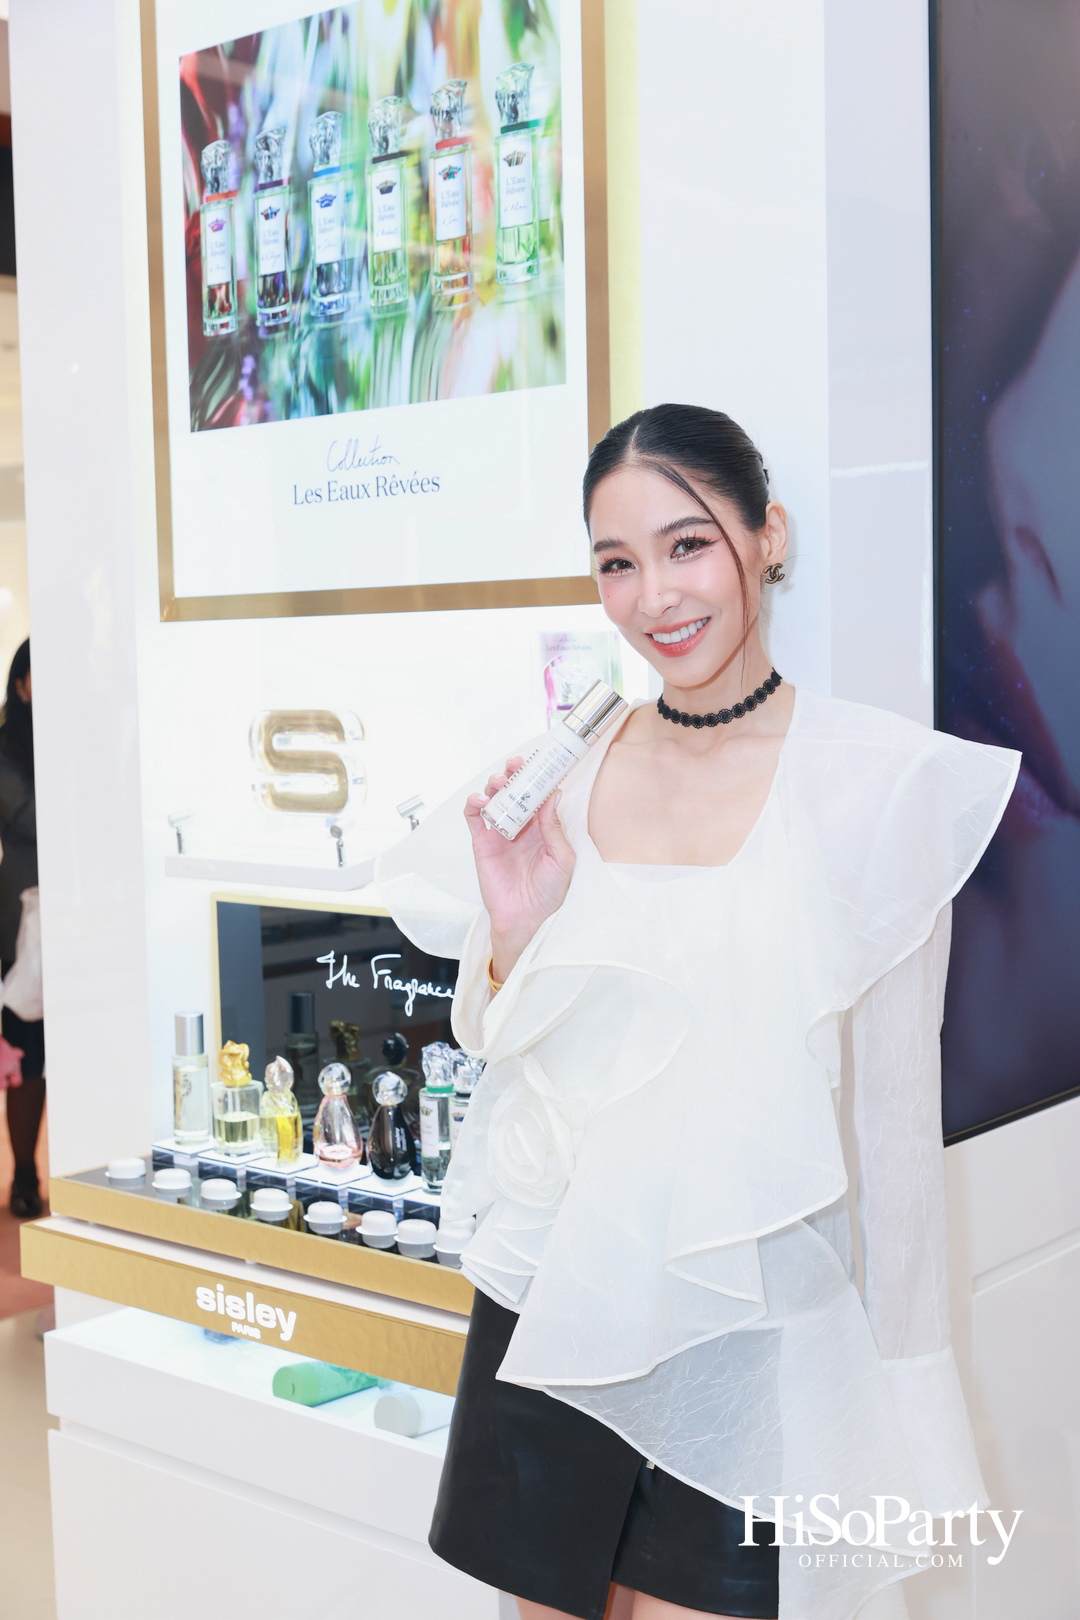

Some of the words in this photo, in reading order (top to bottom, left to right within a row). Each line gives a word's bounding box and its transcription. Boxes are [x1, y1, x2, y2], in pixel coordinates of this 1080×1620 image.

[326, 434, 401, 473] Collection
[293, 484, 323, 506] Les
[327, 480, 371, 503] Eaux
[375, 470, 441, 498] Rêvées
[315, 949, 361, 990] The
[196, 1283, 297, 1341] sisley
[231, 1320, 262, 1340] PARIS
